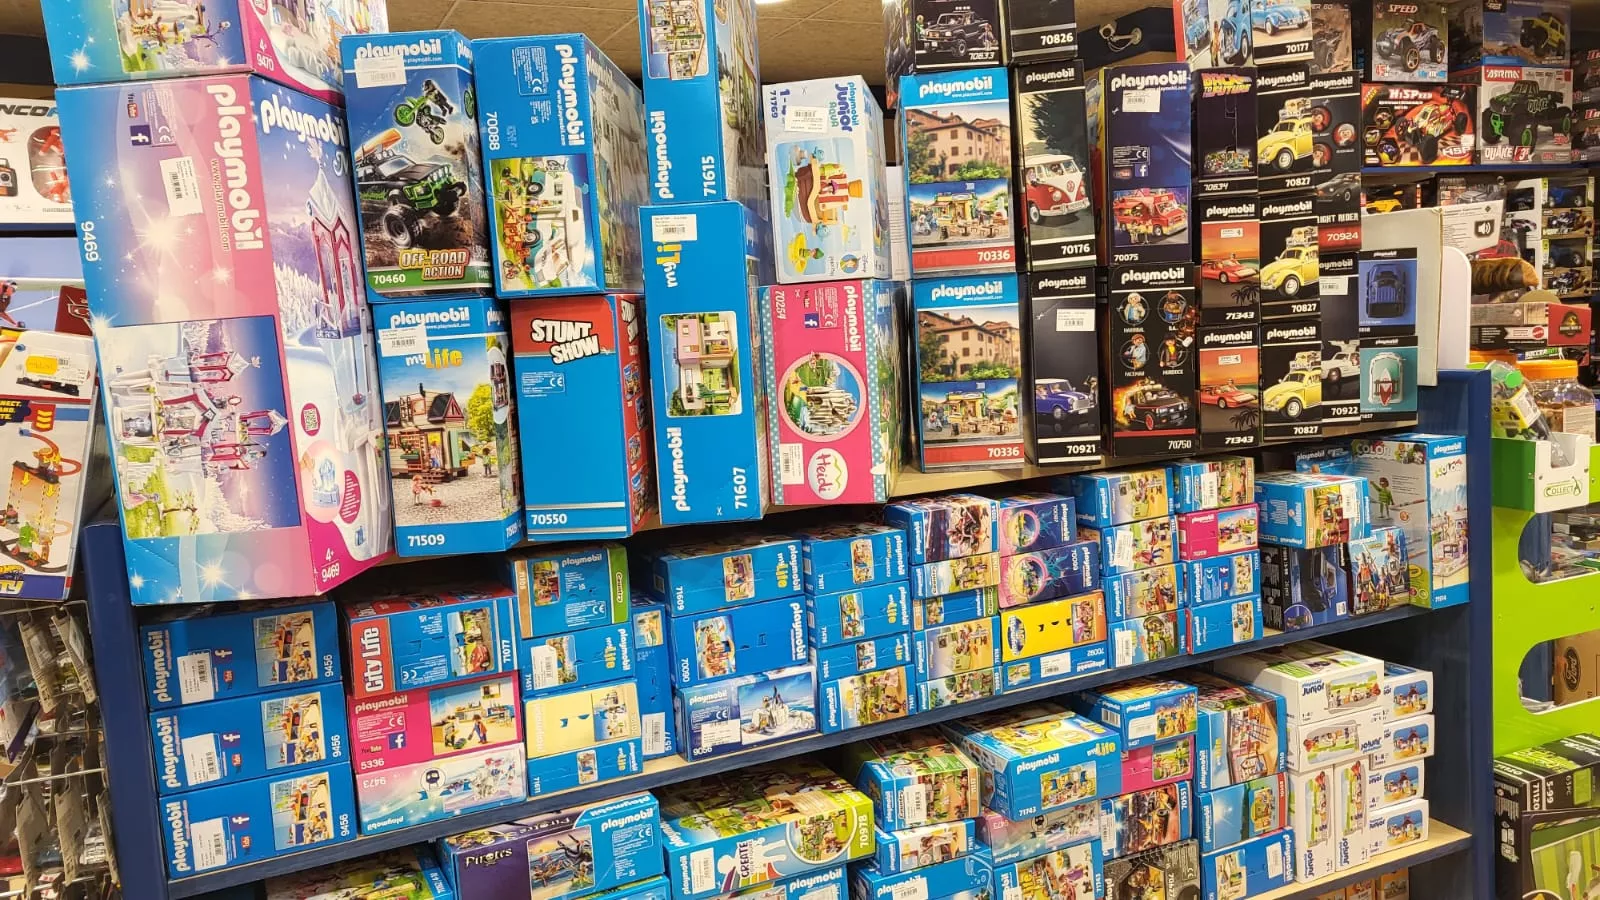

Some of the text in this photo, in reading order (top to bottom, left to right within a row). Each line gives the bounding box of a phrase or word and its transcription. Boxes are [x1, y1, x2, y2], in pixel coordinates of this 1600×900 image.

[1388, 4, 1418, 14] SPEED
[356, 39, 442, 59] playmobil
[1041, 33, 1074, 46] 70826
[1286, 43, 1309, 53] 70177
[256, 54, 276, 72] 9470
[919, 76, 993, 98] playmobil
[1026, 68, 1075, 84] playmobil
[1111, 70, 1188, 92] playmobil
[1256, 72, 1305, 88] playmobil
[1310, 76, 1353, 90] playmobil
[555, 44, 585, 146] playmobil
[768, 90, 778, 118] 71769
[847, 82, 859, 126] playmobil
[260, 98, 347, 149] playmobil
[486, 112, 500, 150] 70088
[650, 110, 675, 200] playmobil
[1485, 146, 1512, 160] QUAKE
[207, 84, 264, 250] playmobil
[702, 156, 716, 196] 71615
[1285, 177, 1310, 188] 70827
[211, 159, 231, 251] www.playmobil.com
[1206, 204, 1256, 218] playmobil
[1262, 201, 1312, 216] playmobil
[80, 221, 99, 262] 9469
[1326, 232, 1358, 242] 70924
[978, 250, 1010, 262] 70336
[1061, 244, 1090, 256] 70176
[1114, 254, 1138, 262] 70075
[374, 274, 406, 284] 70460
[423, 264, 463, 278] ACTION
[1121, 268, 1185, 284] playmobil
[931, 281, 1002, 301] playmobil
[1038, 276, 1087, 290] playmobil
[774, 290, 787, 320] 70254
[1225, 312, 1254, 320] 71343
[1292, 304, 1317, 313] 70827
[390, 306, 470, 328] playmobil
[844, 286, 862, 352] playmobil
[531, 318, 593, 344] STUNT
[1204, 331, 1253, 344] playmobil
[1266, 326, 1316, 340] playmobil
[406, 348, 464, 370] my Life
[550, 336, 600, 365] SHOW
[1331, 407, 1358, 416] 70922
[1225, 436, 1254, 444] 71343
[1293, 426, 1318, 435] 70827
[988, 446, 1020, 458] 70336
[1066, 444, 1096, 454] 70921
[1434, 442, 1462, 455] playmobil
[667, 427, 691, 512] playmobil
[816, 453, 833, 493] Heidi
[732, 467, 748, 509] 71607
[531, 513, 568, 525] 70550
[1061, 504, 1070, 542] playmobil
[408, 534, 445, 547] 71509
[561, 553, 602, 568] playmobil
[894, 535, 905, 576] playmobil
[322, 562, 340, 582] 9469
[788, 544, 801, 592] playmobil
[1082, 547, 1092, 588] playmobil
[1194, 563, 1202, 602] playmobil
[676, 586, 684, 610] 71609
[898, 586, 909, 626] playmobil
[1113, 581, 1122, 617] playmobil
[790, 602, 806, 660] playmobil
[502, 640, 512, 664] 71077
[618, 628, 630, 671] playmobil
[148, 630, 172, 703] playmobil
[324, 654, 334, 678] 9456
[680, 658, 690, 683] 70090
[1076, 659, 1106, 672] playmobil
[355, 694, 408, 714] playmobil
[689, 690, 728, 706] playmobil
[826, 687, 837, 726] playmobil
[1126, 701, 1150, 713] playmobil
[156, 717, 182, 788] playmobil
[332, 734, 342, 758] 9456
[1094, 741, 1116, 756] Life
[360, 758, 385, 770] 5336
[1016, 753, 1060, 774] playmobil
[1200, 750, 1209, 789] playmobil
[362, 776, 387, 789] 9473
[1546, 780, 1554, 804] 5-99
[589, 795, 650, 818] playmobil
[1019, 806, 1036, 817] 71743
[340, 814, 350, 837] 9456
[367, 816, 404, 832] playmobil
[600, 807, 654, 833] playmobil
[858, 814, 868, 848] 70978
[1204, 804, 1212, 844] playmobil
[166, 802, 190, 872] playmobil
[738, 842, 750, 879] CREATE
[1282, 834, 1294, 882] playmobil
[680, 855, 690, 895] playmobil
[788, 868, 843, 893] playmobil
